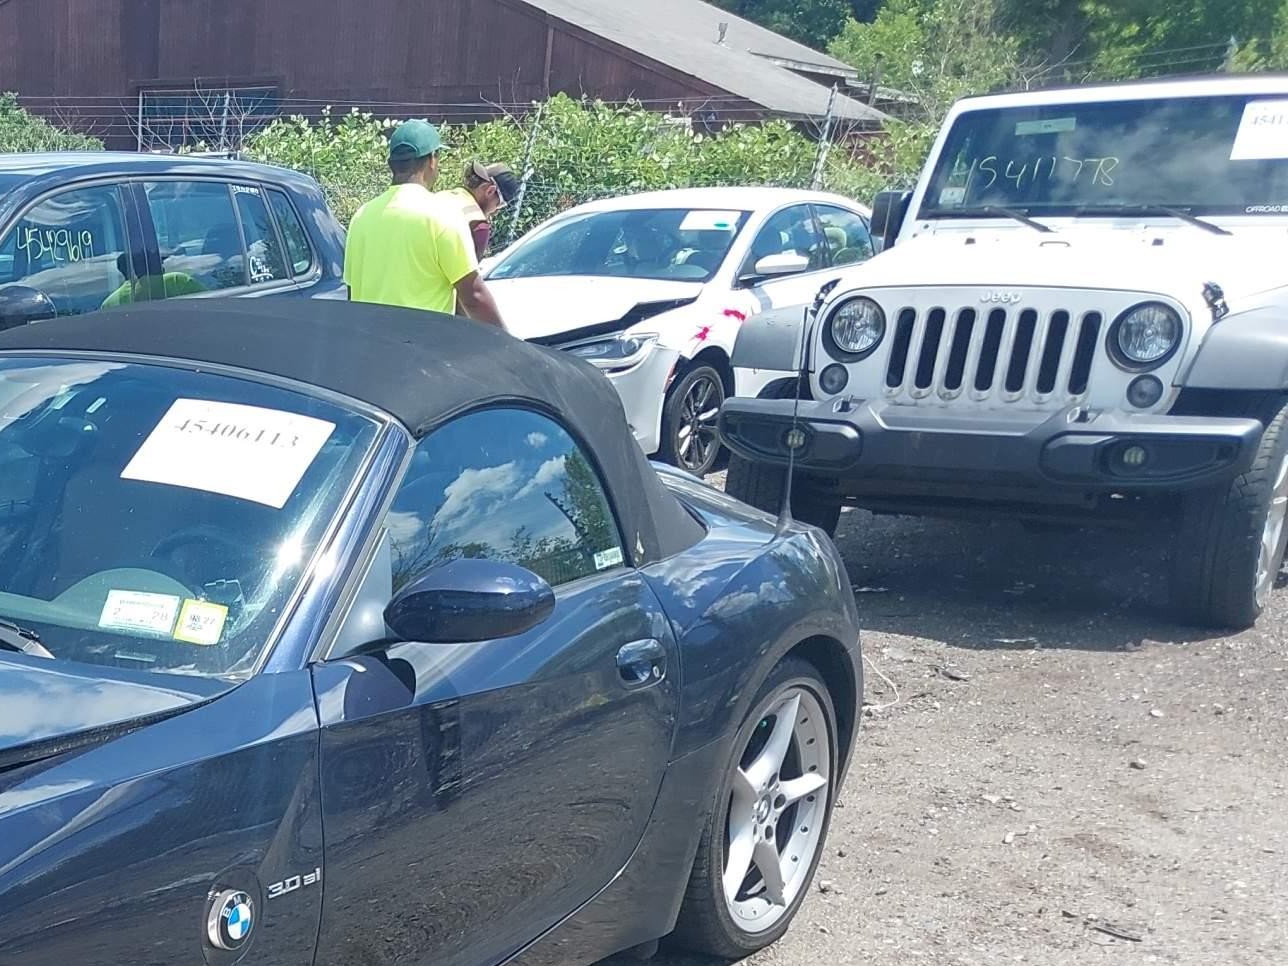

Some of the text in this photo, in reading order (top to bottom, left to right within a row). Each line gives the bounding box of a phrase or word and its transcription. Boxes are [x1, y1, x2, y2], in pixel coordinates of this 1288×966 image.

[980, 290, 1022, 306] Jeep
[174, 418, 300, 448] 45406113
[222, 895, 253, 918] BMW
